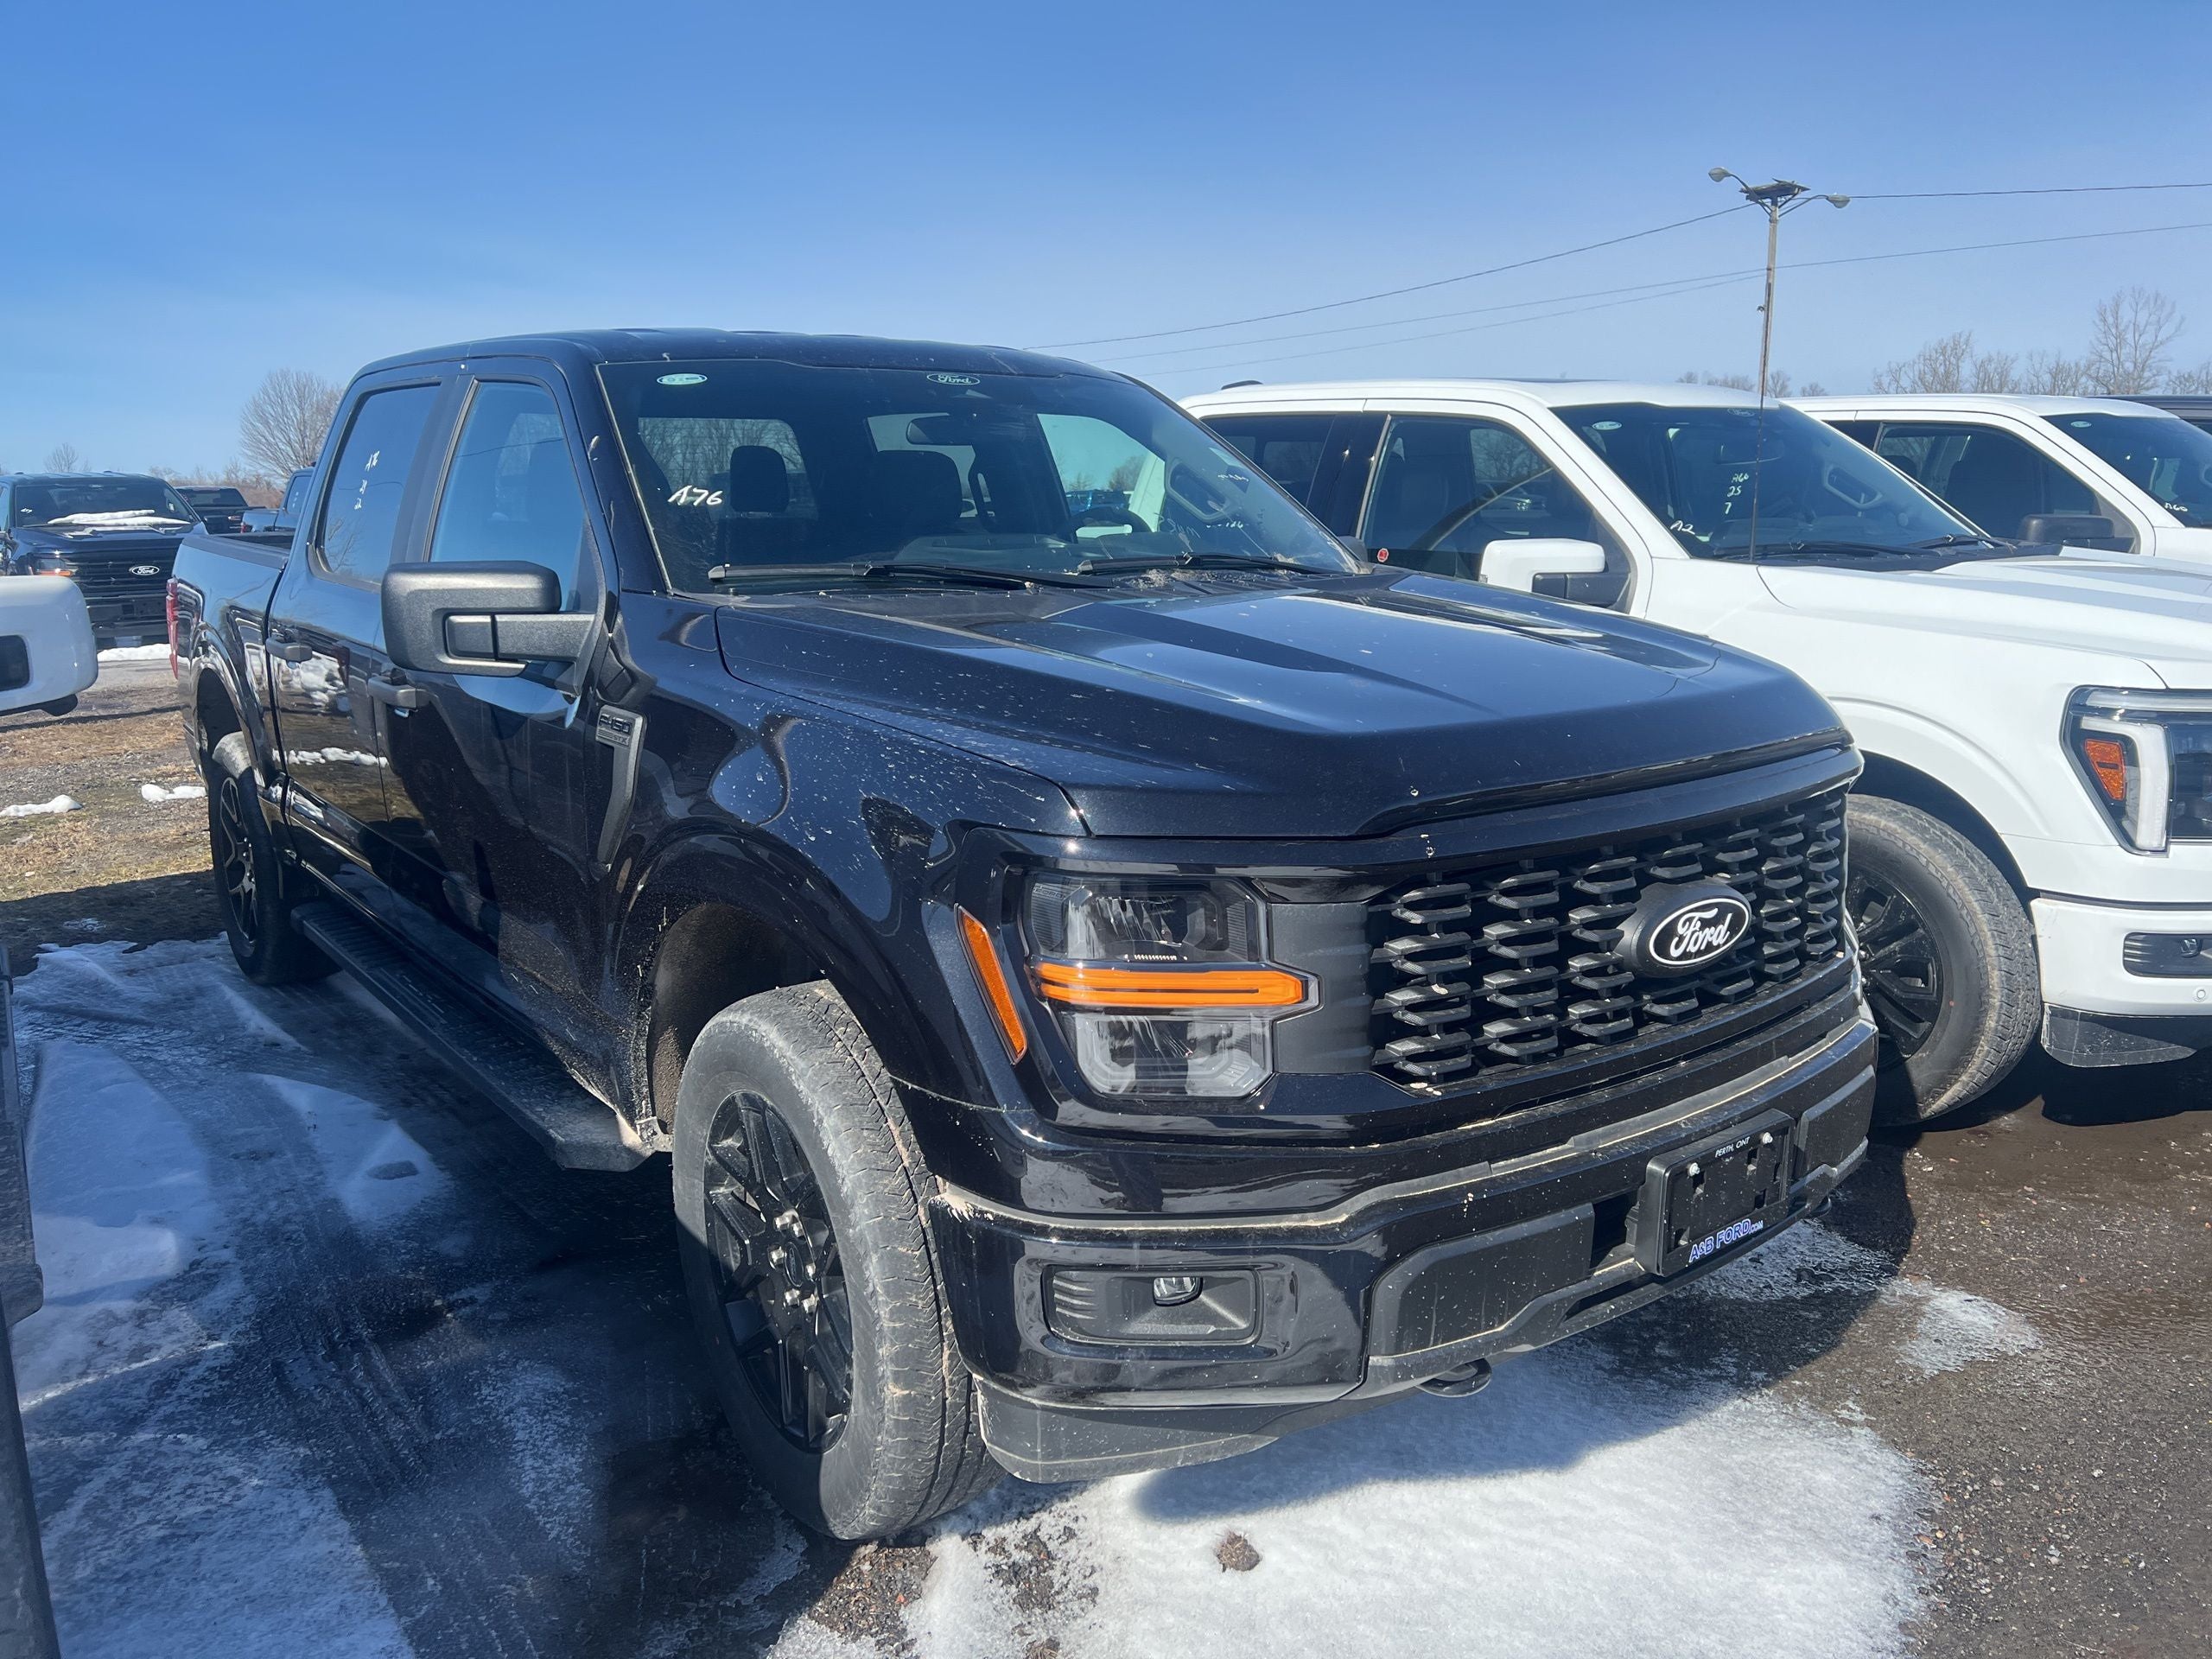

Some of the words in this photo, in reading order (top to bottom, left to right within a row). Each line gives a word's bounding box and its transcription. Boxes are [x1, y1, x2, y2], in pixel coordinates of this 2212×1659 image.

[938, 374, 972, 384] Ford
[668, 485, 723, 505] A76
[1727, 486, 1742, 498] 25
[613, 735, 630, 746] STX
[1669, 906, 1734, 958] Ford
[1736, 1136, 1750, 1148] ONT
[1688, 1236, 1714, 1263] A&B
